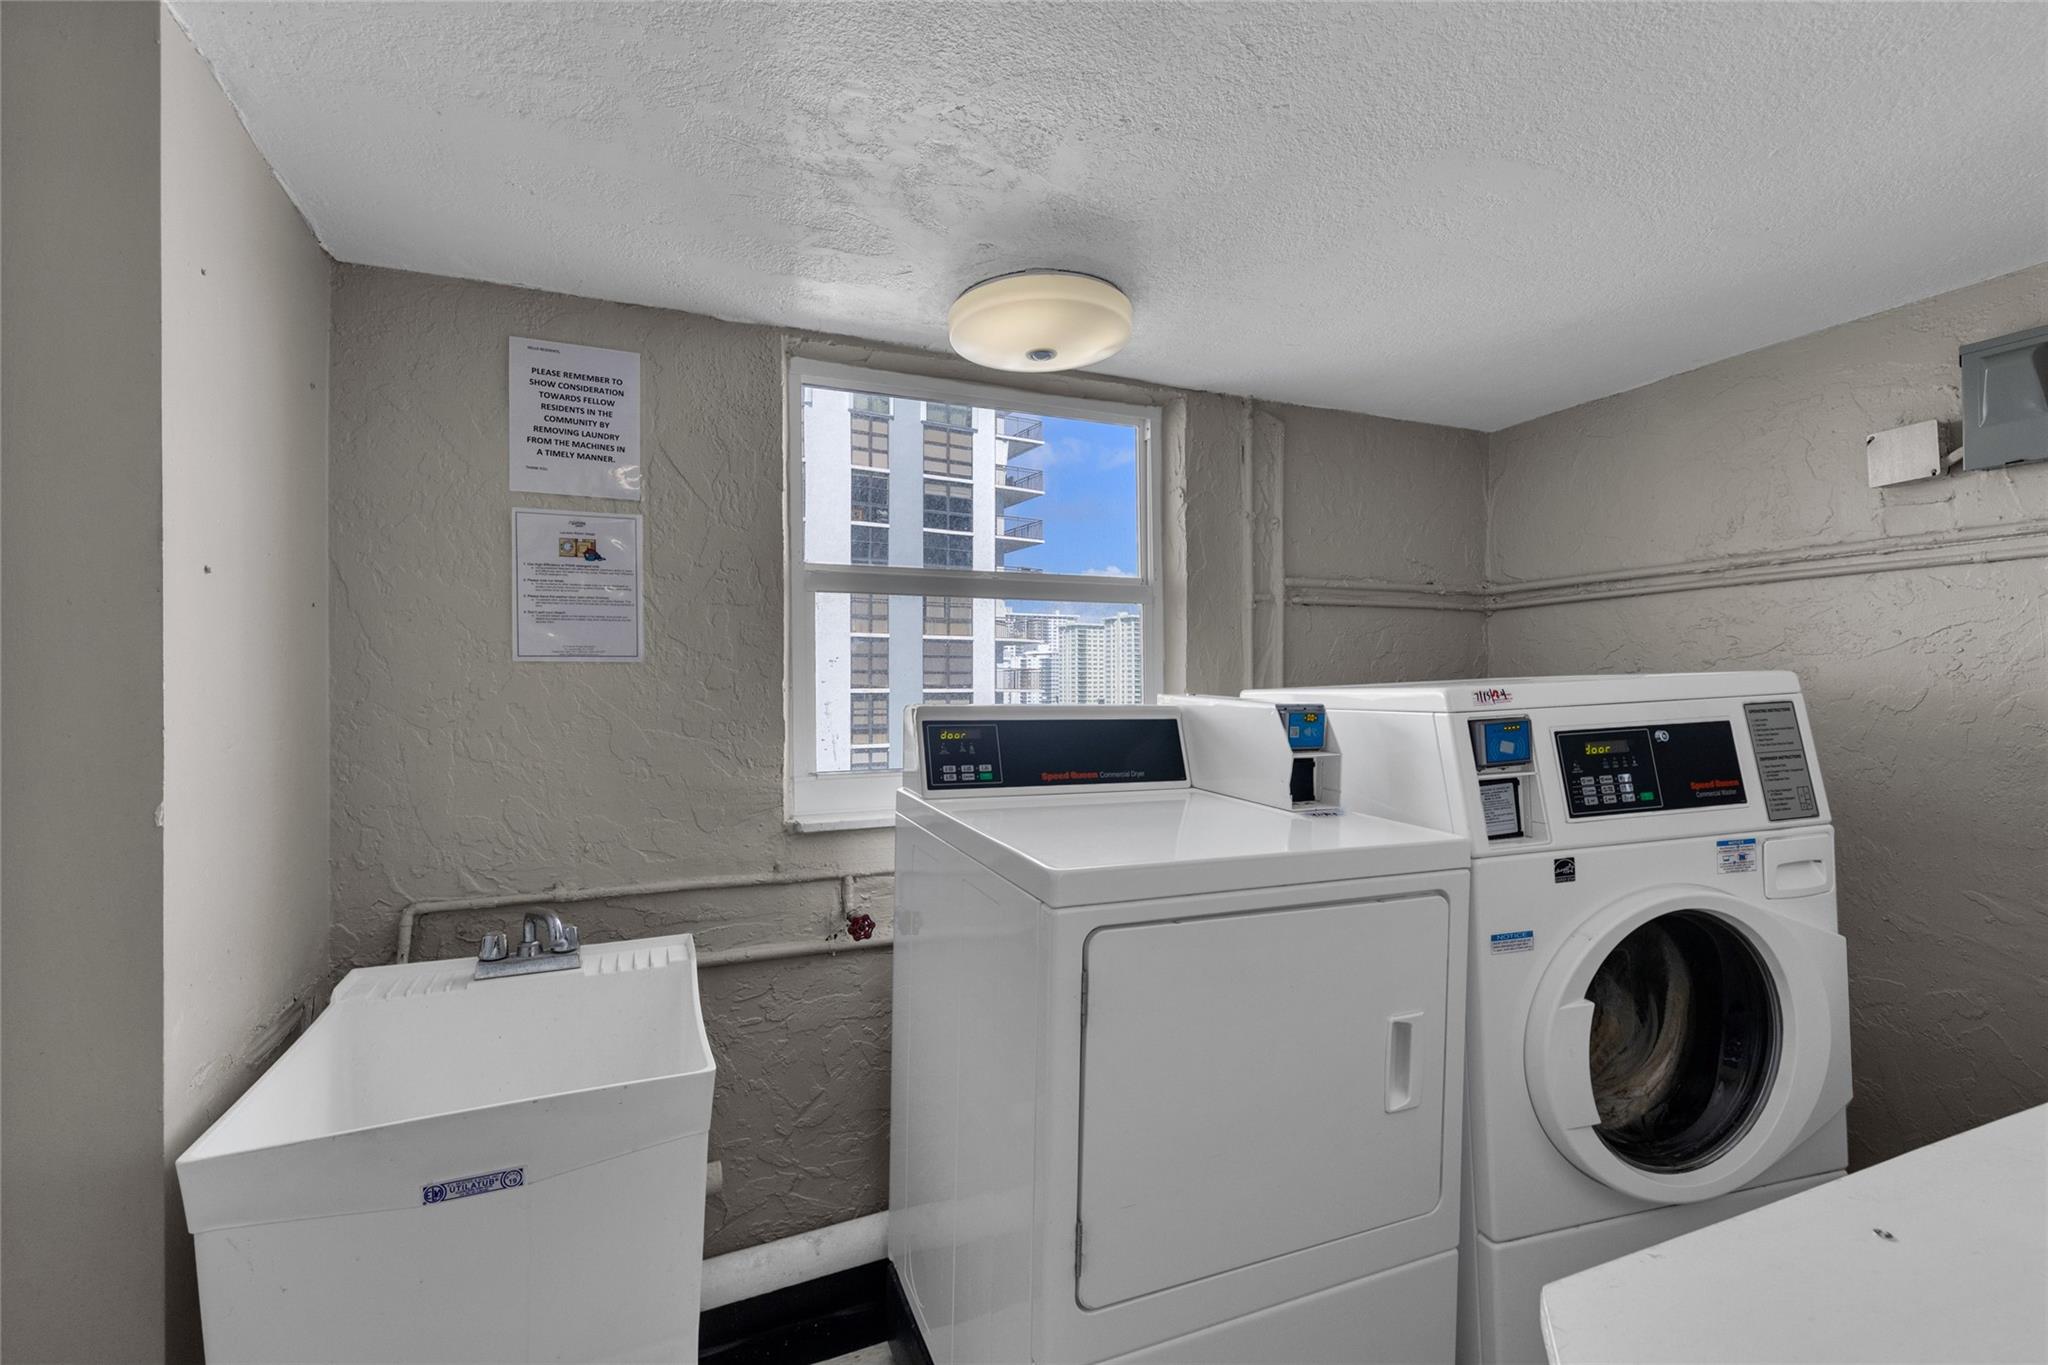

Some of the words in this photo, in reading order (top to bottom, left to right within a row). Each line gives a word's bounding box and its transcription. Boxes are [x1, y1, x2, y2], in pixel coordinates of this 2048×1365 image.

[531, 367, 561, 378] PLEASE
[563, 371, 610, 384] REMEMBER
[612, 378, 623, 386] TO
[529, 378, 556, 388] SHOW
[558, 382, 625, 397] CONSIDERATION
[539, 391, 581, 403] TOWARDS
[583, 397, 616, 407] FELLOW
[541, 403, 585, 415] RESIDENTS
[597, 410, 613, 418] THE
[543, 415, 598, 428] COMMUNITY
[599, 421, 610, 429] BY
[533, 425, 579, 437] REMOVING
[581, 430, 620, 441] LAUNDRY
[527, 436, 552, 445] FROM
[554, 439, 570, 447] THE
[572, 441, 615, 452] MACHINES
[536, 448, 543, 456] A
[545, 449, 575, 459] TIMELY
[576, 453, 616, 463] MANNER.
[940, 730, 966, 740] door
[1041, 771, 1070, 782] Speed
[1071, 770, 1098, 779] Queen
[1496, 931, 1525, 939] NOTICE
